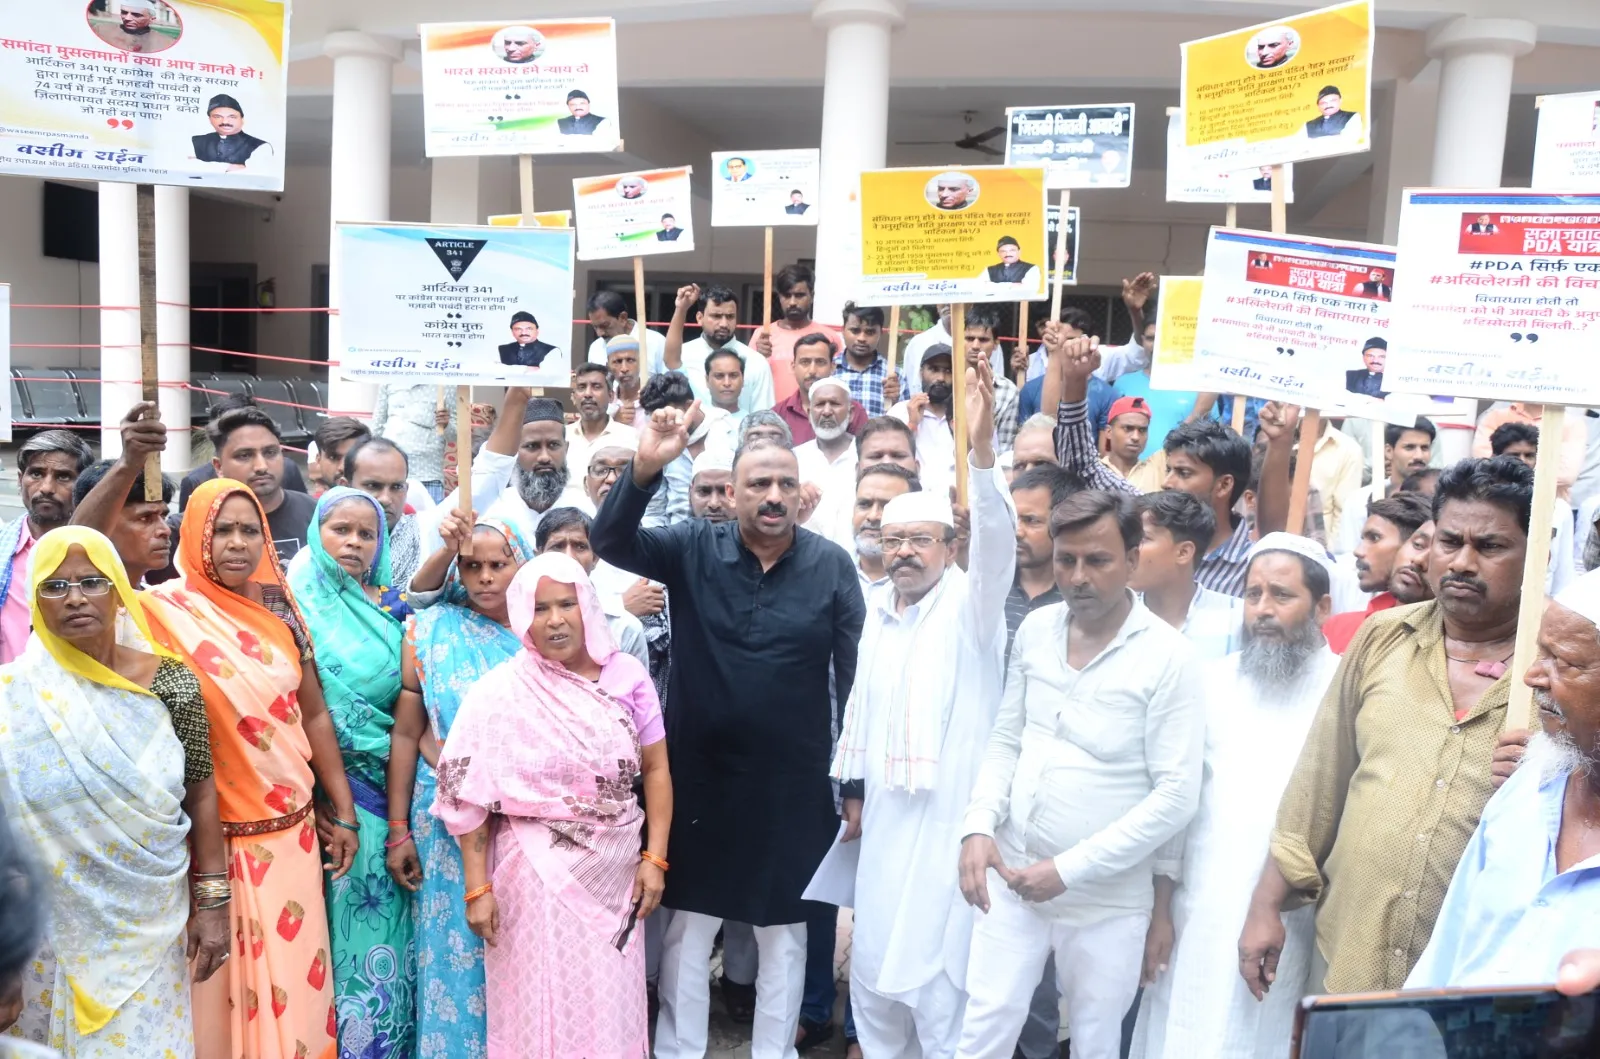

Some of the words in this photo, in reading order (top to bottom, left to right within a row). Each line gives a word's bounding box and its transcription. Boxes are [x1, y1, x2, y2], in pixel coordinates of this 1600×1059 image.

[0, 39, 52, 54] समांदा
[56, 45, 130, 63] मुसलमानों
[132, 56, 162, 68] क्या
[166, 58, 195, 71] आप
[198, 62, 236, 76] जानते
[1328, 54, 1356, 66] सरकार
[25, 56, 76, 70] आर्टिकल
[80, 64, 99, 72] 341
[103, 66, 117, 74] पर
[120, 67, 154, 78] कांग्रेस
[160, 71, 174, 80] की
[205, 77, 239, 88] सरकार
[444, 66, 474, 76] भारत
[478, 66, 518, 76] सरकार
[543, 65, 572, 74] न्याय
[36, 70, 58, 80] द्वारा
[63, 72, 94, 83] लगाई
[98, 76, 114, 85] गई
[192, 86, 201, 94] से
[35, 80, 50, 89] 74
[54, 82, 72, 92] वर्ष
[88, 86, 107, 96] कई
[140, 91, 171, 100] ब्लॉक
[80, 105, 94, 114] जो
[98, 106, 118, 116] नहीं
[106, 98, 140, 108] सदस्य
[142, 102, 170, 112] प्रधान
[16, 142, 88, 159] वसीम
[94, 148, 148, 164] राईन
[1523, 240, 1562, 252] PDA
[1566, 240, 1600, 253] यात्र
[1470, 260, 1523, 271] #PDA
[1290, 266, 1346, 282] समाजवादी
[1430, 272, 1532, 288] #अखिलेशजी
[1536, 276, 1560, 288] की
[421, 282, 469, 293] आर्टिकल
[472, 286, 493, 294] 341
[1289, 276, 1314, 288] PDA
[1253, 287, 1288, 299] #PDA
[1322, 297, 1341, 307] एक
[1344, 300, 1367, 311] नारा
[1370, 302, 1378, 313] है
[1476, 294, 1532, 304] विचारधारा
[1536, 296, 1562, 305] होती
[1565, 296, 1580, 306] तो
[1226, 296, 1292, 312] #अखिलेशजी
[1296, 304, 1310, 315] की
[1315, 307, 1370, 324] विचारधारा
[1470, 304, 1487, 314] को
[1492, 306, 1504, 315] भी
[1557, 308, 1570, 318] के
[424, 320, 458, 330] कांग्रेस
[462, 322, 484, 332] मुक्त
[370, 356, 418, 368] वसीम
